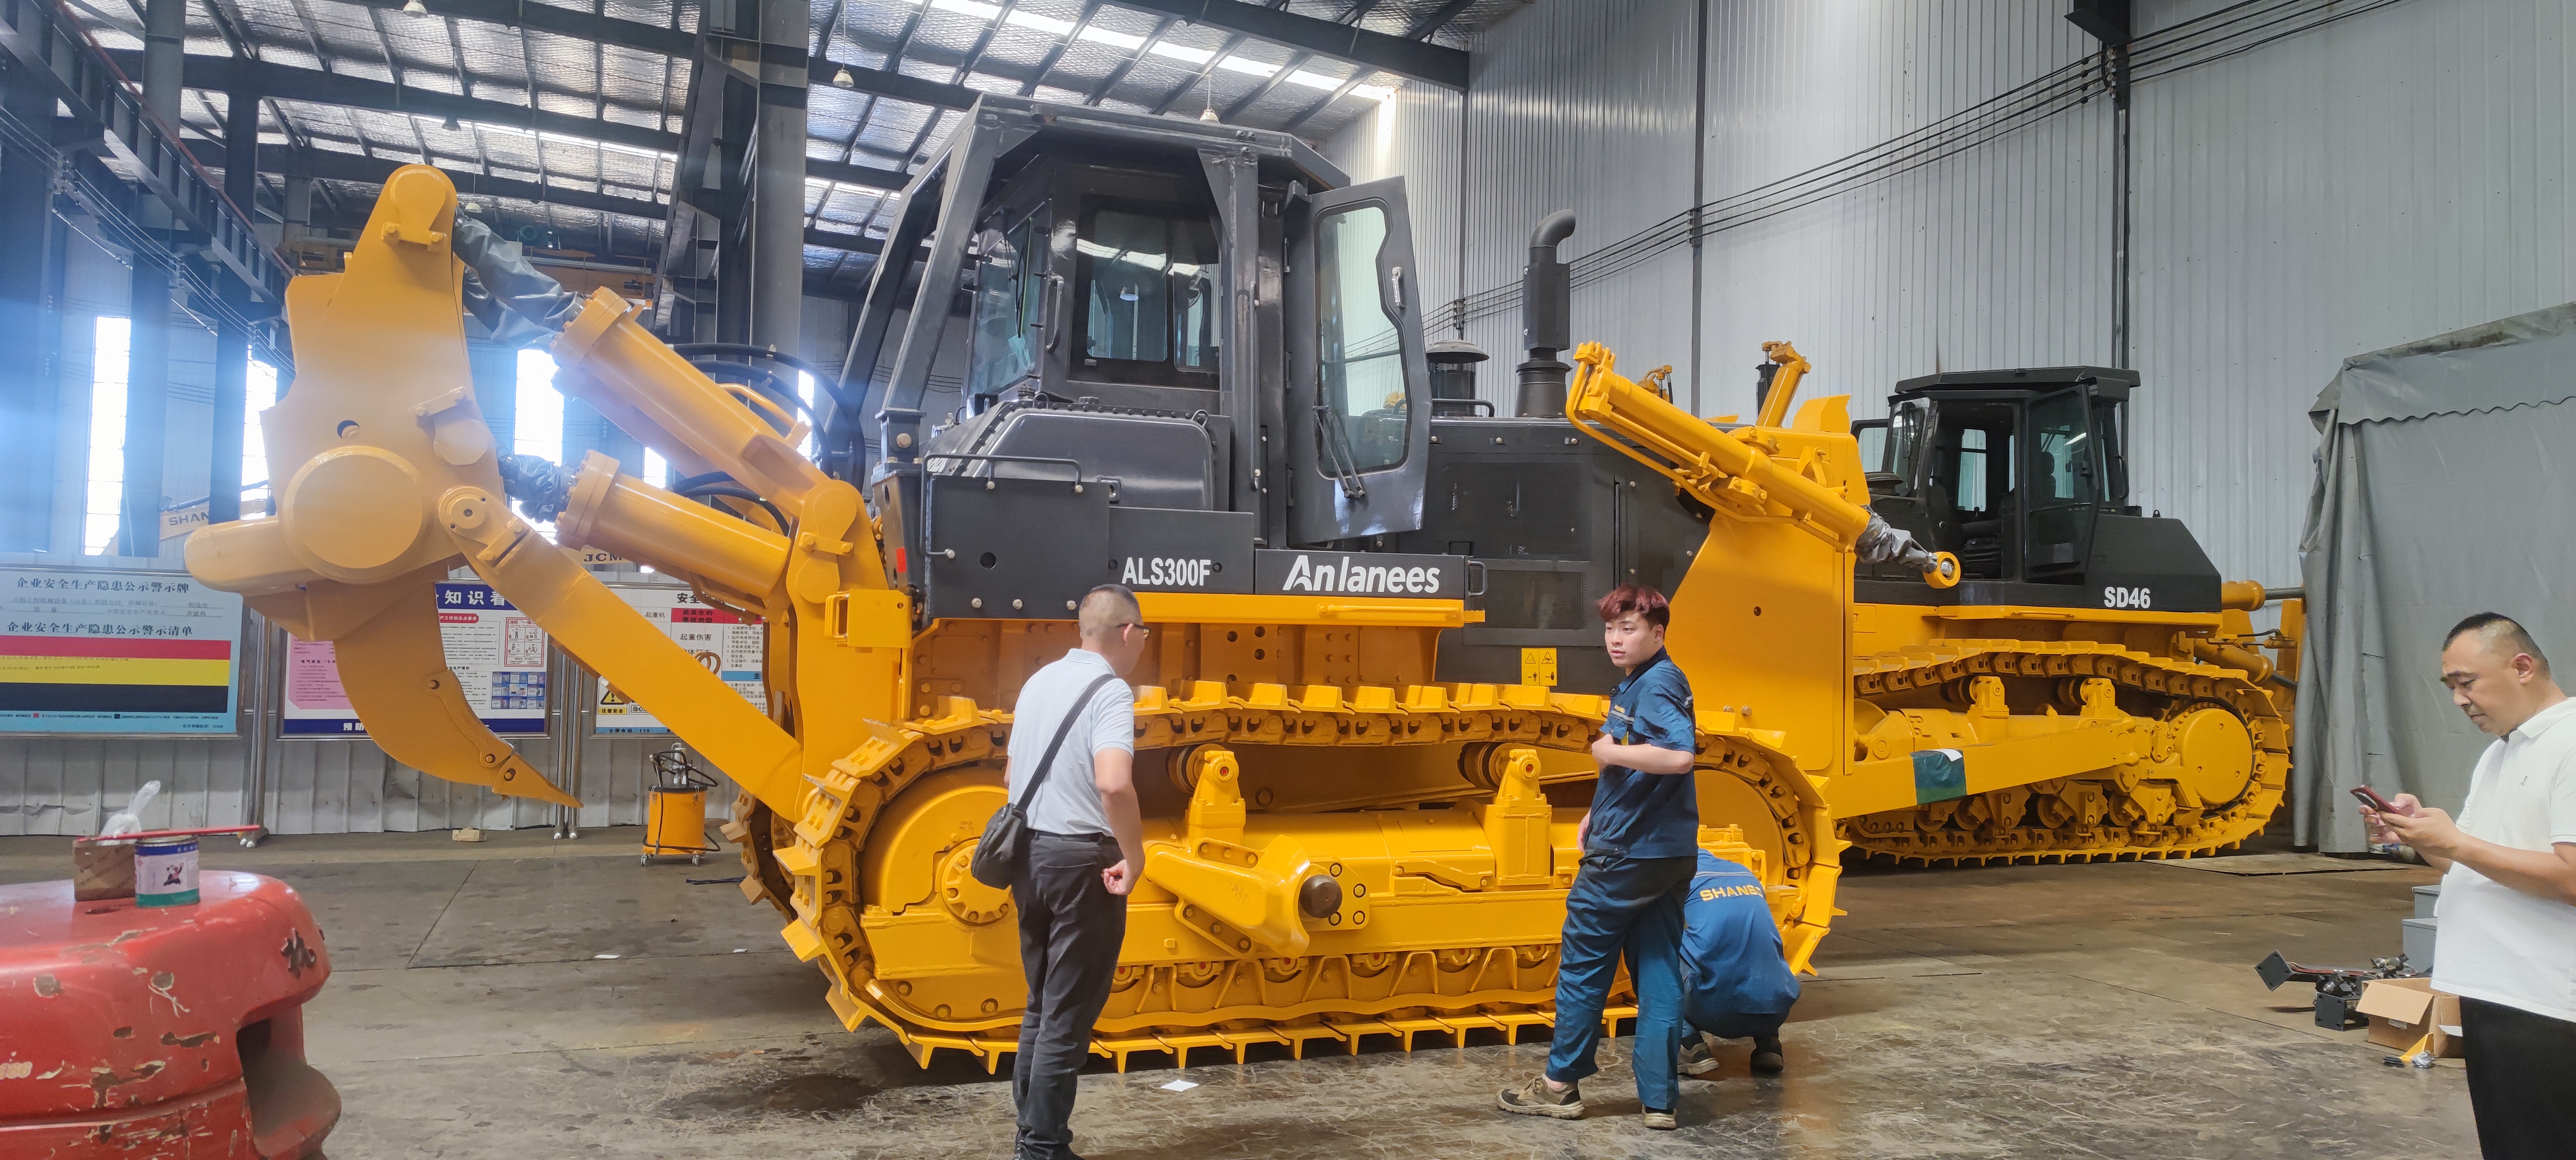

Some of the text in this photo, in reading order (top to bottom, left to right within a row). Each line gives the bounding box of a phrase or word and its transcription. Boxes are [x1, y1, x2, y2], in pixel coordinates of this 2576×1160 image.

[1121, 557, 1211, 586] ALS300F
[1282, 555, 1440, 593] Anlanees
[17, 577, 189, 594] 企业安全生产隐患公示警示牌
[2104, 586, 2151, 609] SD46
[7, 622, 193, 637] 企业安全生产隐患公示警示清单
[680, 633, 712, 641] 起重伤害
